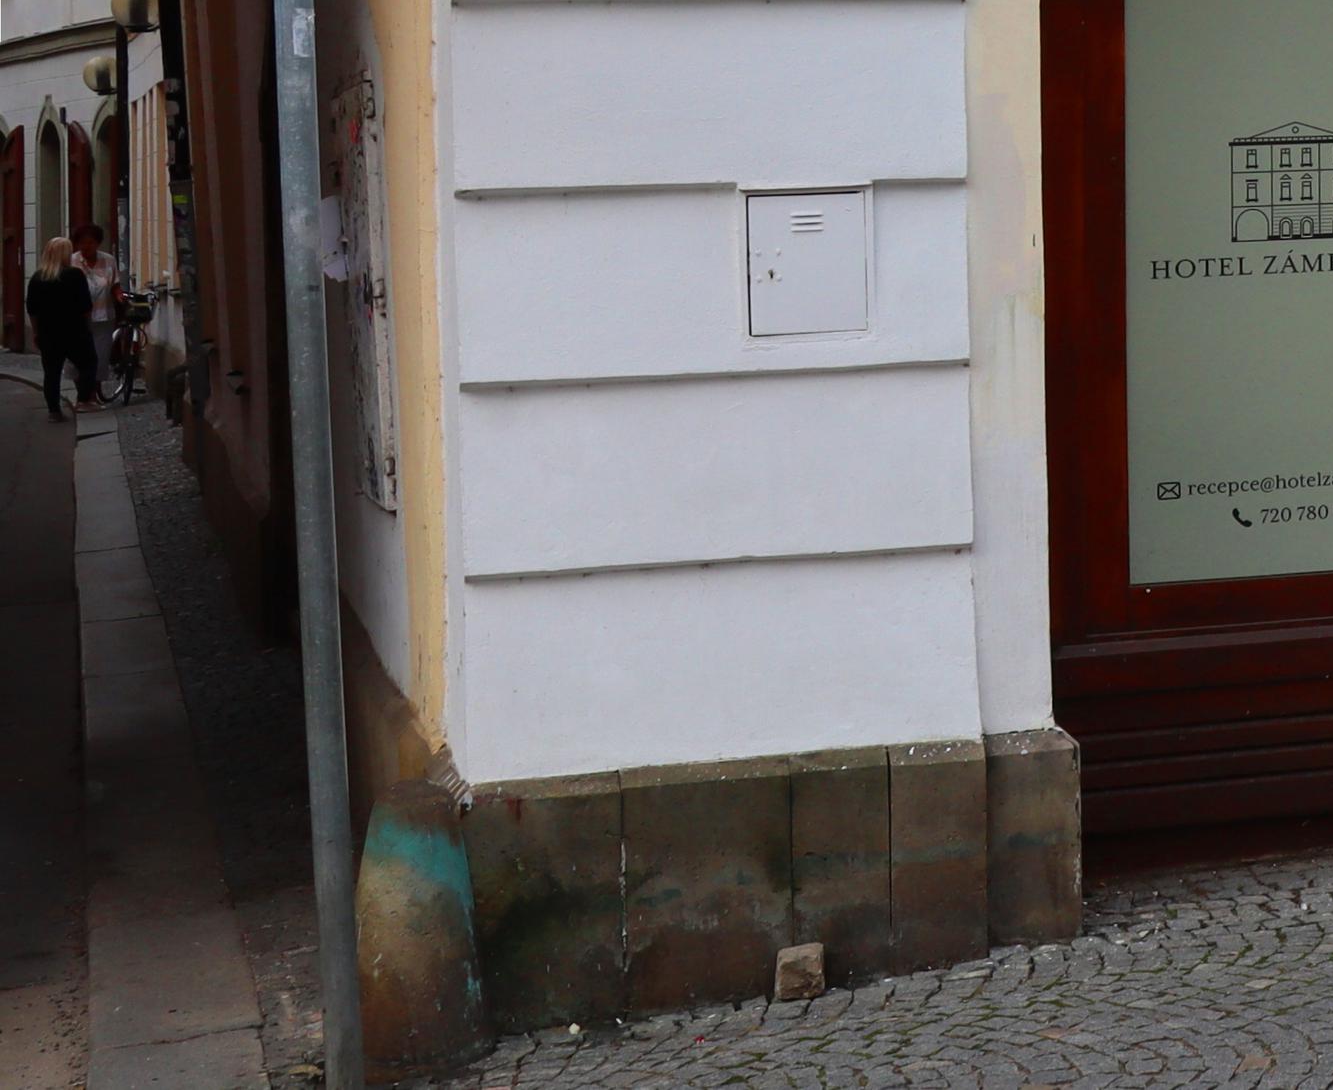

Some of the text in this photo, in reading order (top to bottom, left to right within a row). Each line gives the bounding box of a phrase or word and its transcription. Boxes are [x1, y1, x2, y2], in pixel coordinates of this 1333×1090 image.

[1151, 256, 1253, 280] HOTEL
[1260, 507, 1292, 524] 720
[1297, 504, 1329, 521] 780
